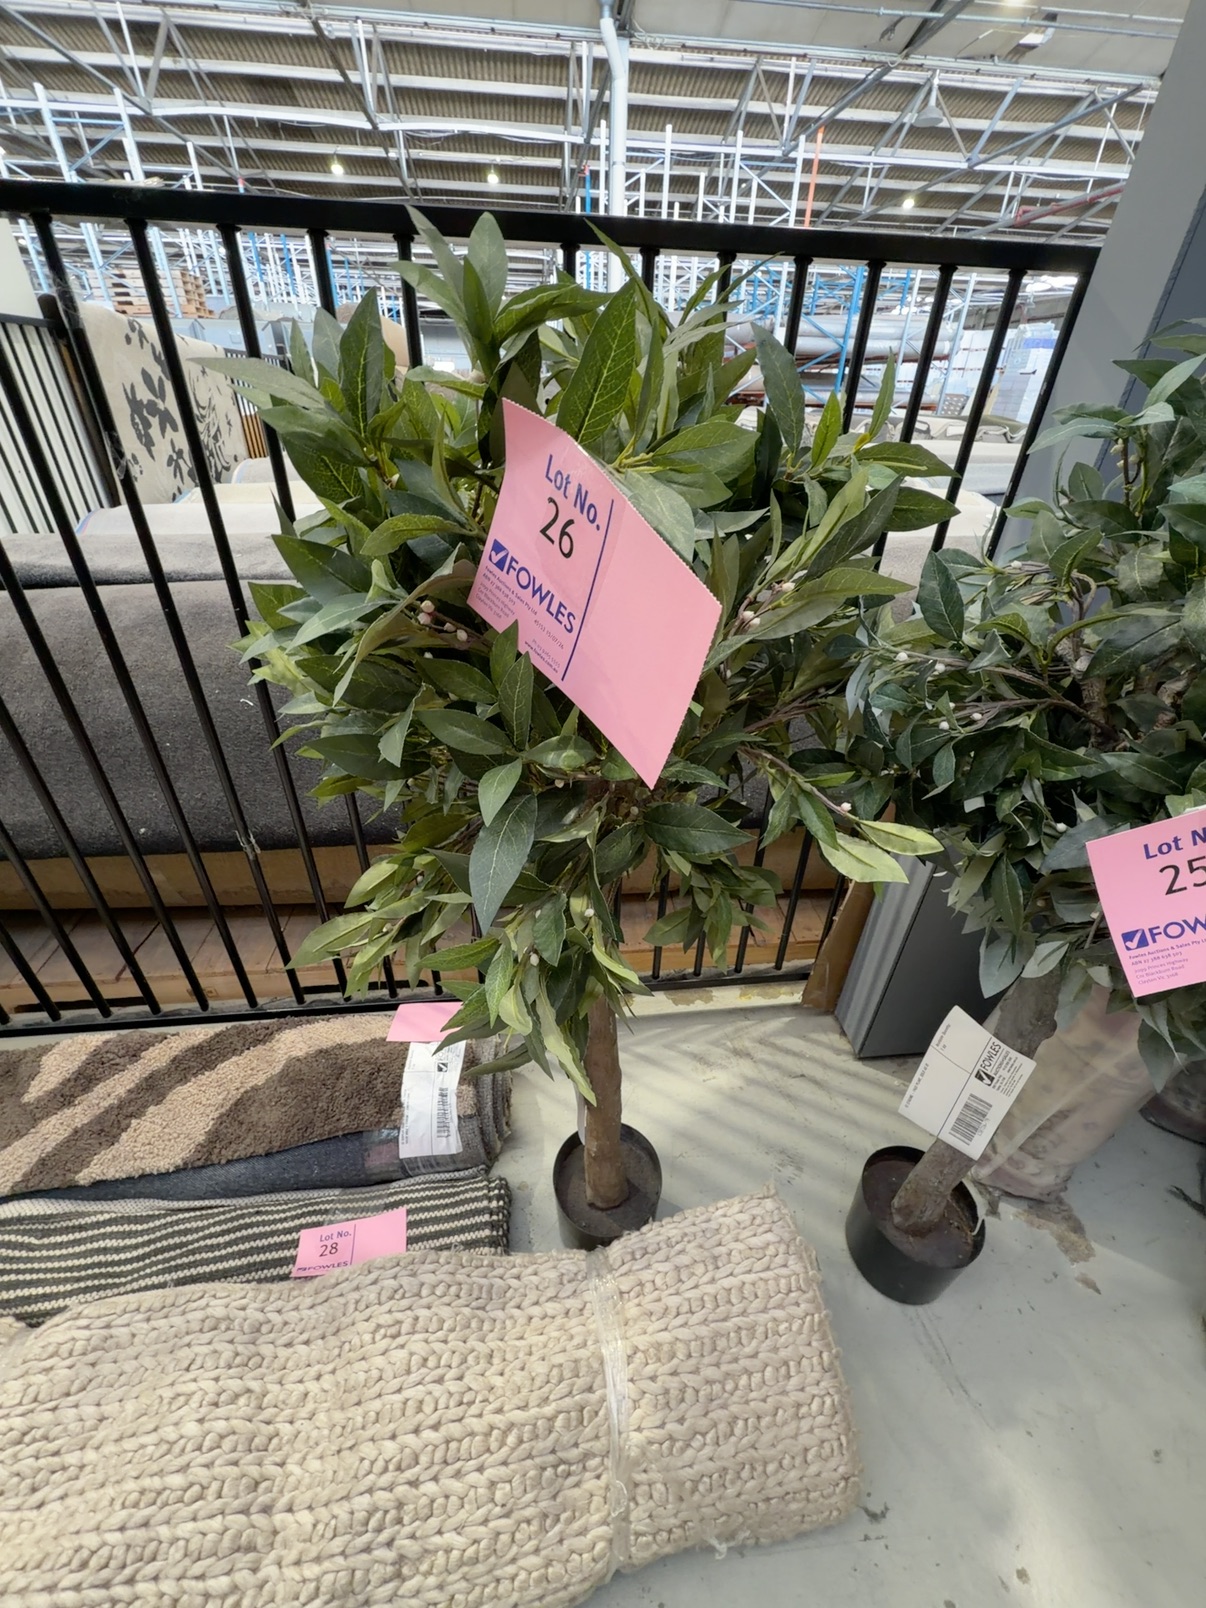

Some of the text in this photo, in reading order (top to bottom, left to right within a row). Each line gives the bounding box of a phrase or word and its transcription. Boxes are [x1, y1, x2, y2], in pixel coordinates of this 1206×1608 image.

[545, 454, 601, 531] Lot No.
[539, 497, 575, 559] 26
[506, 555, 576, 634] FOWLES
[1143, 835, 1184, 860] Lot
[1159, 856, 1206, 895] 25
[1148, 914, 1206, 943] FOW
[1128, 952, 1146, 960] Fowles
[1147, 946, 1169, 955] Auctions
[979, 1041, 1002, 1072] FOWLES
[319, 1242, 338, 1257] 28
[320, 1230, 352, 1242] Lot No.
[306, 1260, 349, 1271] FOWLES
